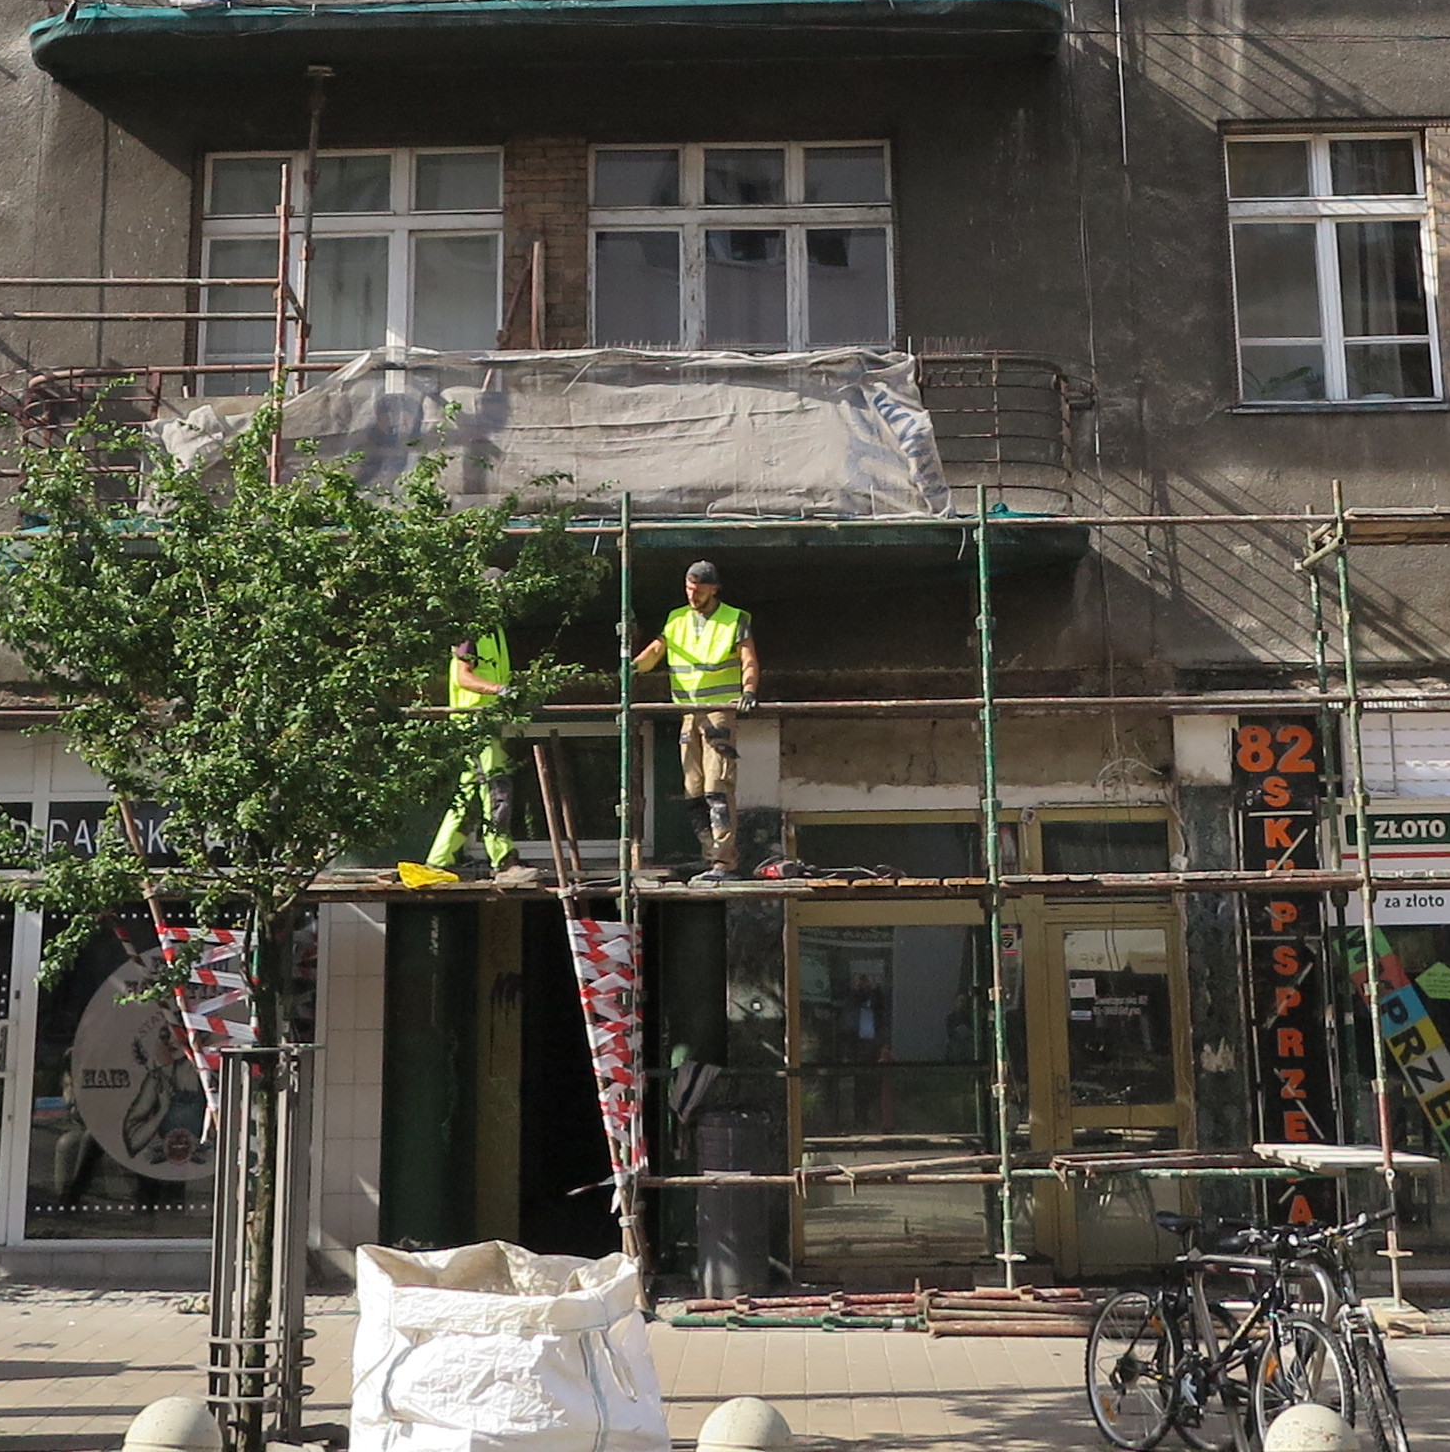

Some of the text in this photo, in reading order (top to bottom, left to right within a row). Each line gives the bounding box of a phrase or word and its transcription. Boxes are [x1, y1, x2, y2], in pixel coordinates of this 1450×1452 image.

[1236, 725, 1316, 773] 82
[1374, 818, 1447, 839] ZŁOTO
[1384, 892, 1445, 908] za złoto
[81, 1068, 131, 1089] HAIR
